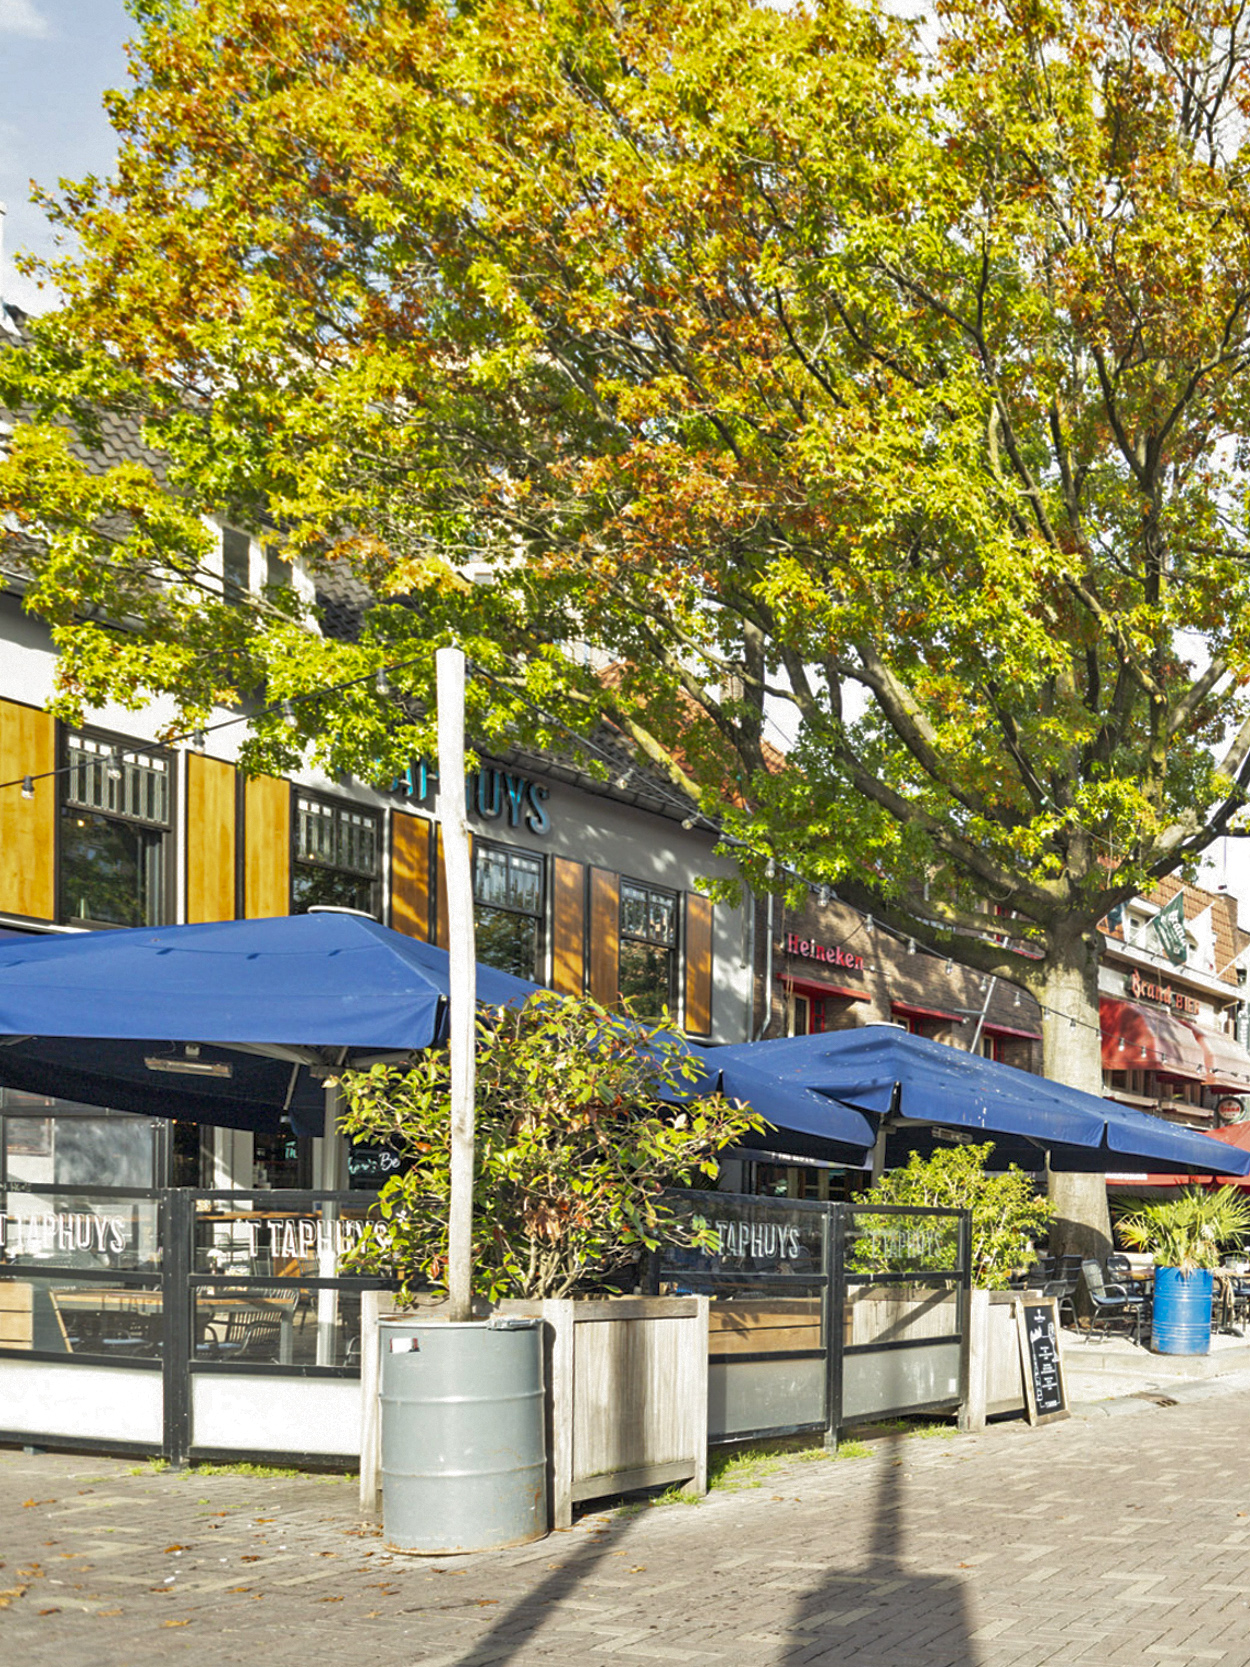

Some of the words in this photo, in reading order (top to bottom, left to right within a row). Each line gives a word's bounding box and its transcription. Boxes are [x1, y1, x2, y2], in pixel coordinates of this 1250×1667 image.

[786, 932, 863, 970] Heineken
[1131, 968, 1172, 1005] Brand
[14, 1211, 126, 1253] TAPHUYS
[715, 1220, 800, 1259] TAPHUYS
